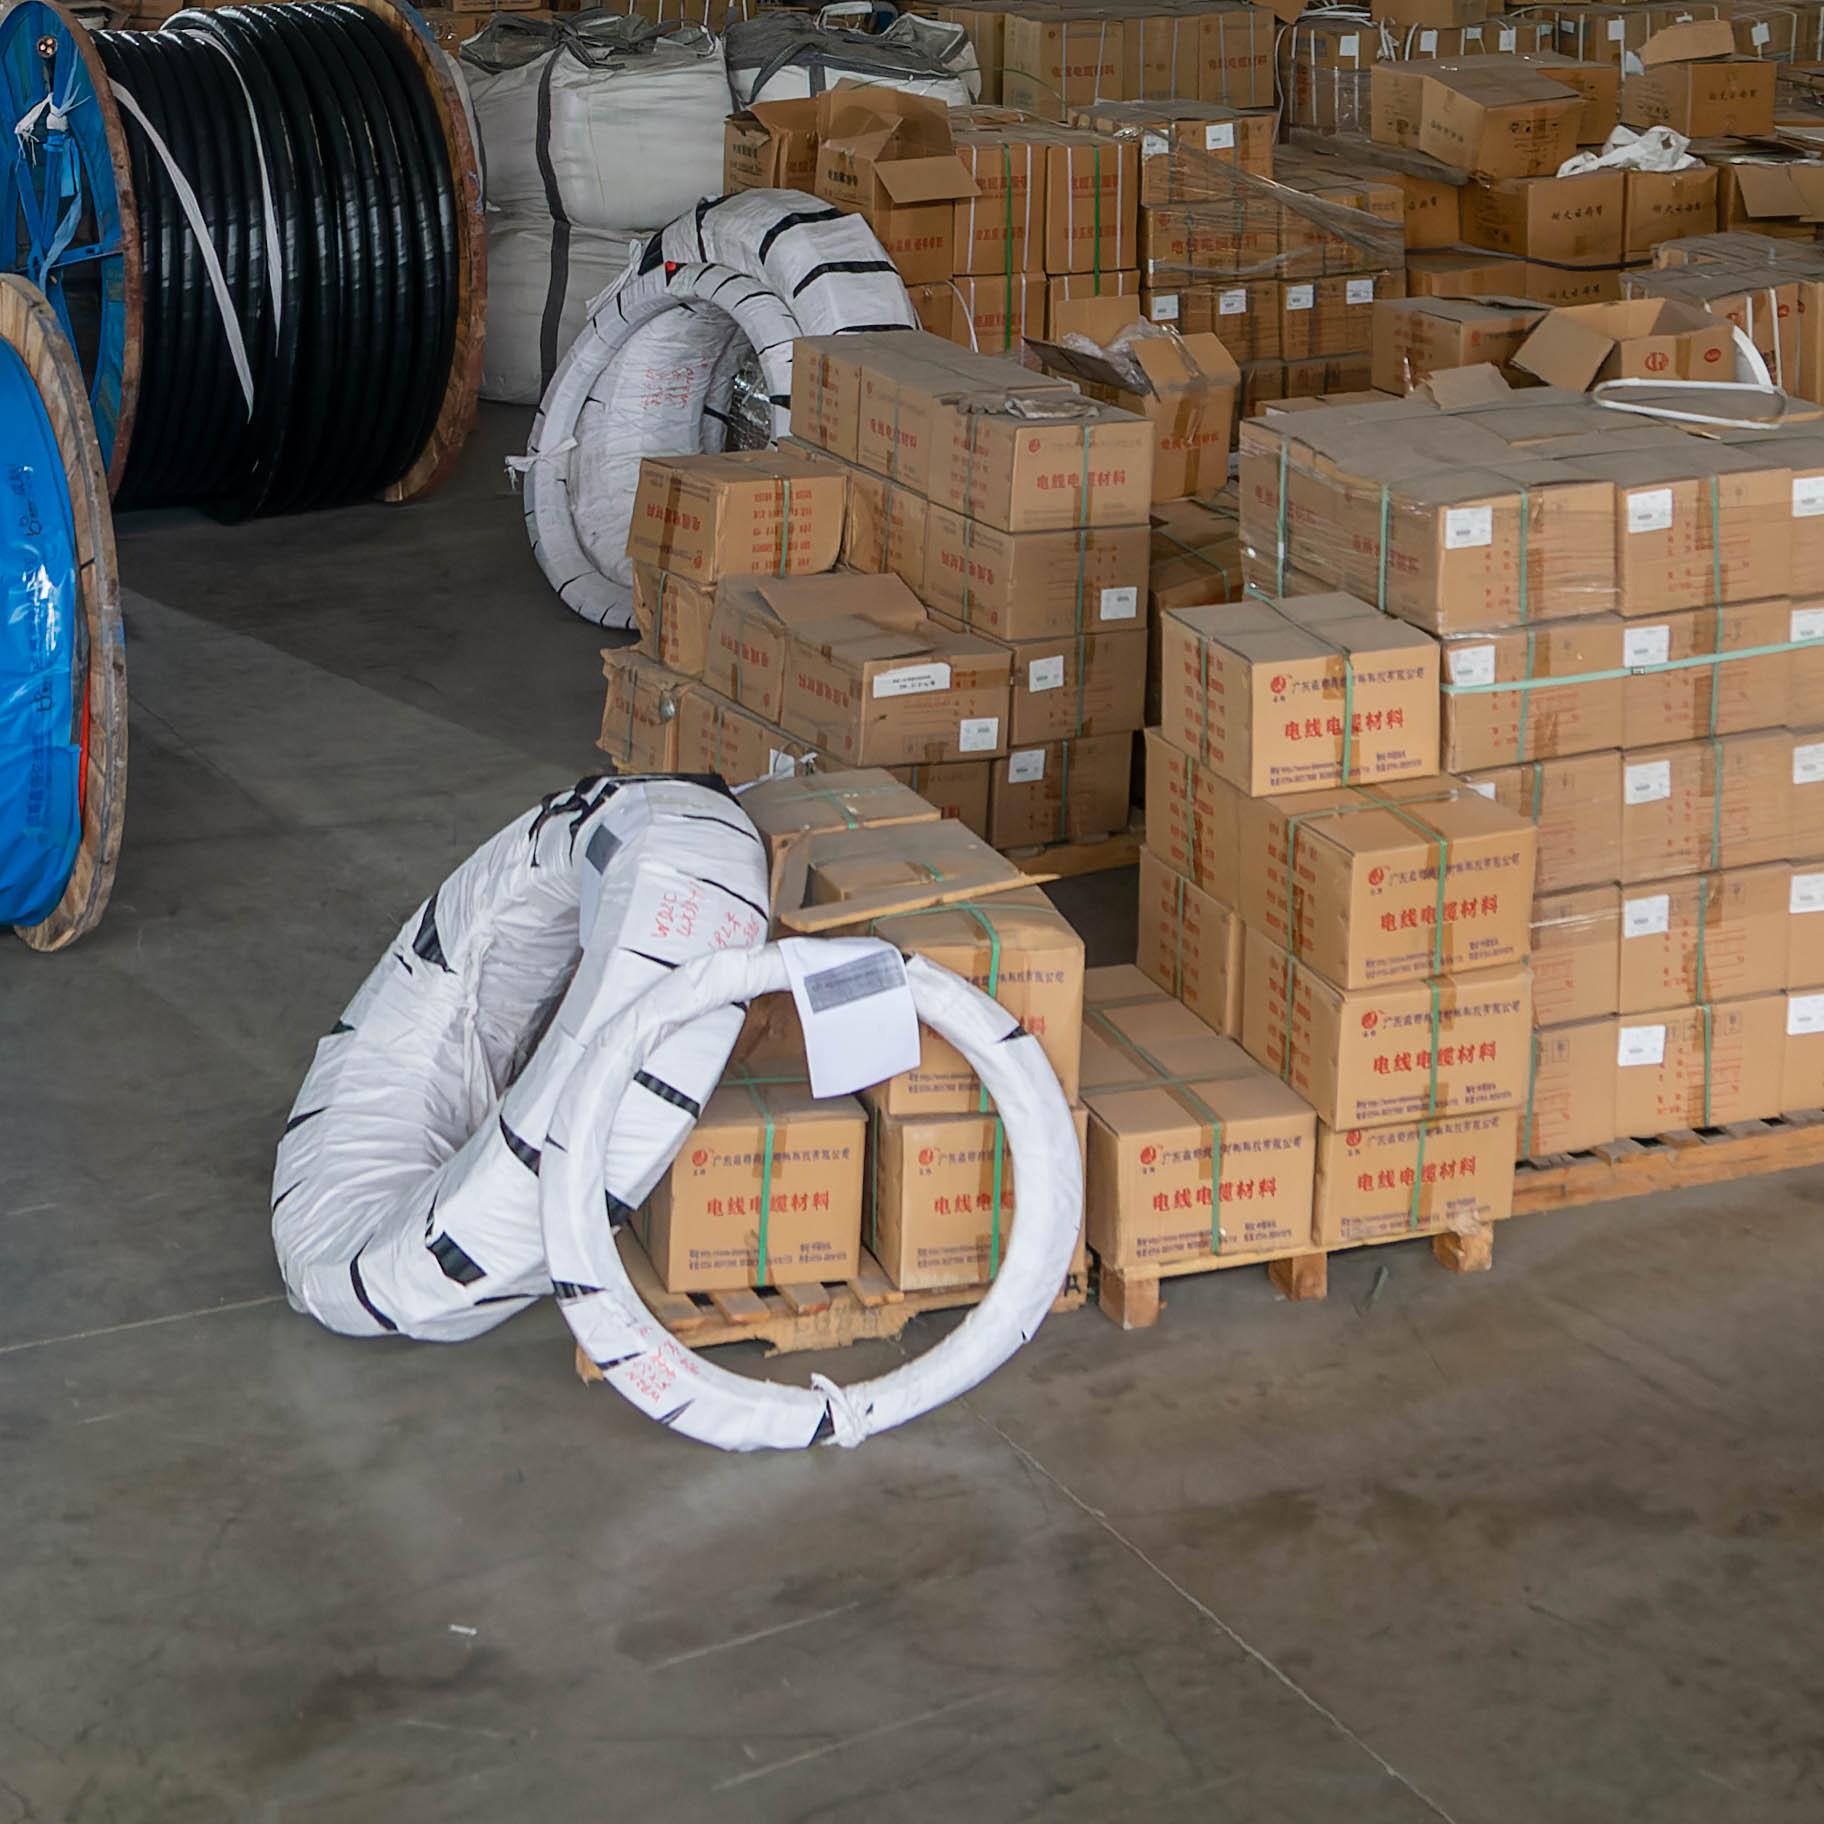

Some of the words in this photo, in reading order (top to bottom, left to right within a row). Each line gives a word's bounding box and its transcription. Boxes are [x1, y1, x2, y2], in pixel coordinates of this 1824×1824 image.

[1036, 470, 1126, 490] 电线电缆材料
[1285, 707, 1404, 741] 电线电缆材料
[1380, 894, 1499, 933] 电线电缆材料
[1373, 1041, 1497, 1076] 电线电缆材料
[1357, 1155, 1477, 1193] 电线电缆材料
[707, 1191, 830, 1217] 电线电缆材料
[1152, 1176, 1277, 1212] 电线电缆材料
